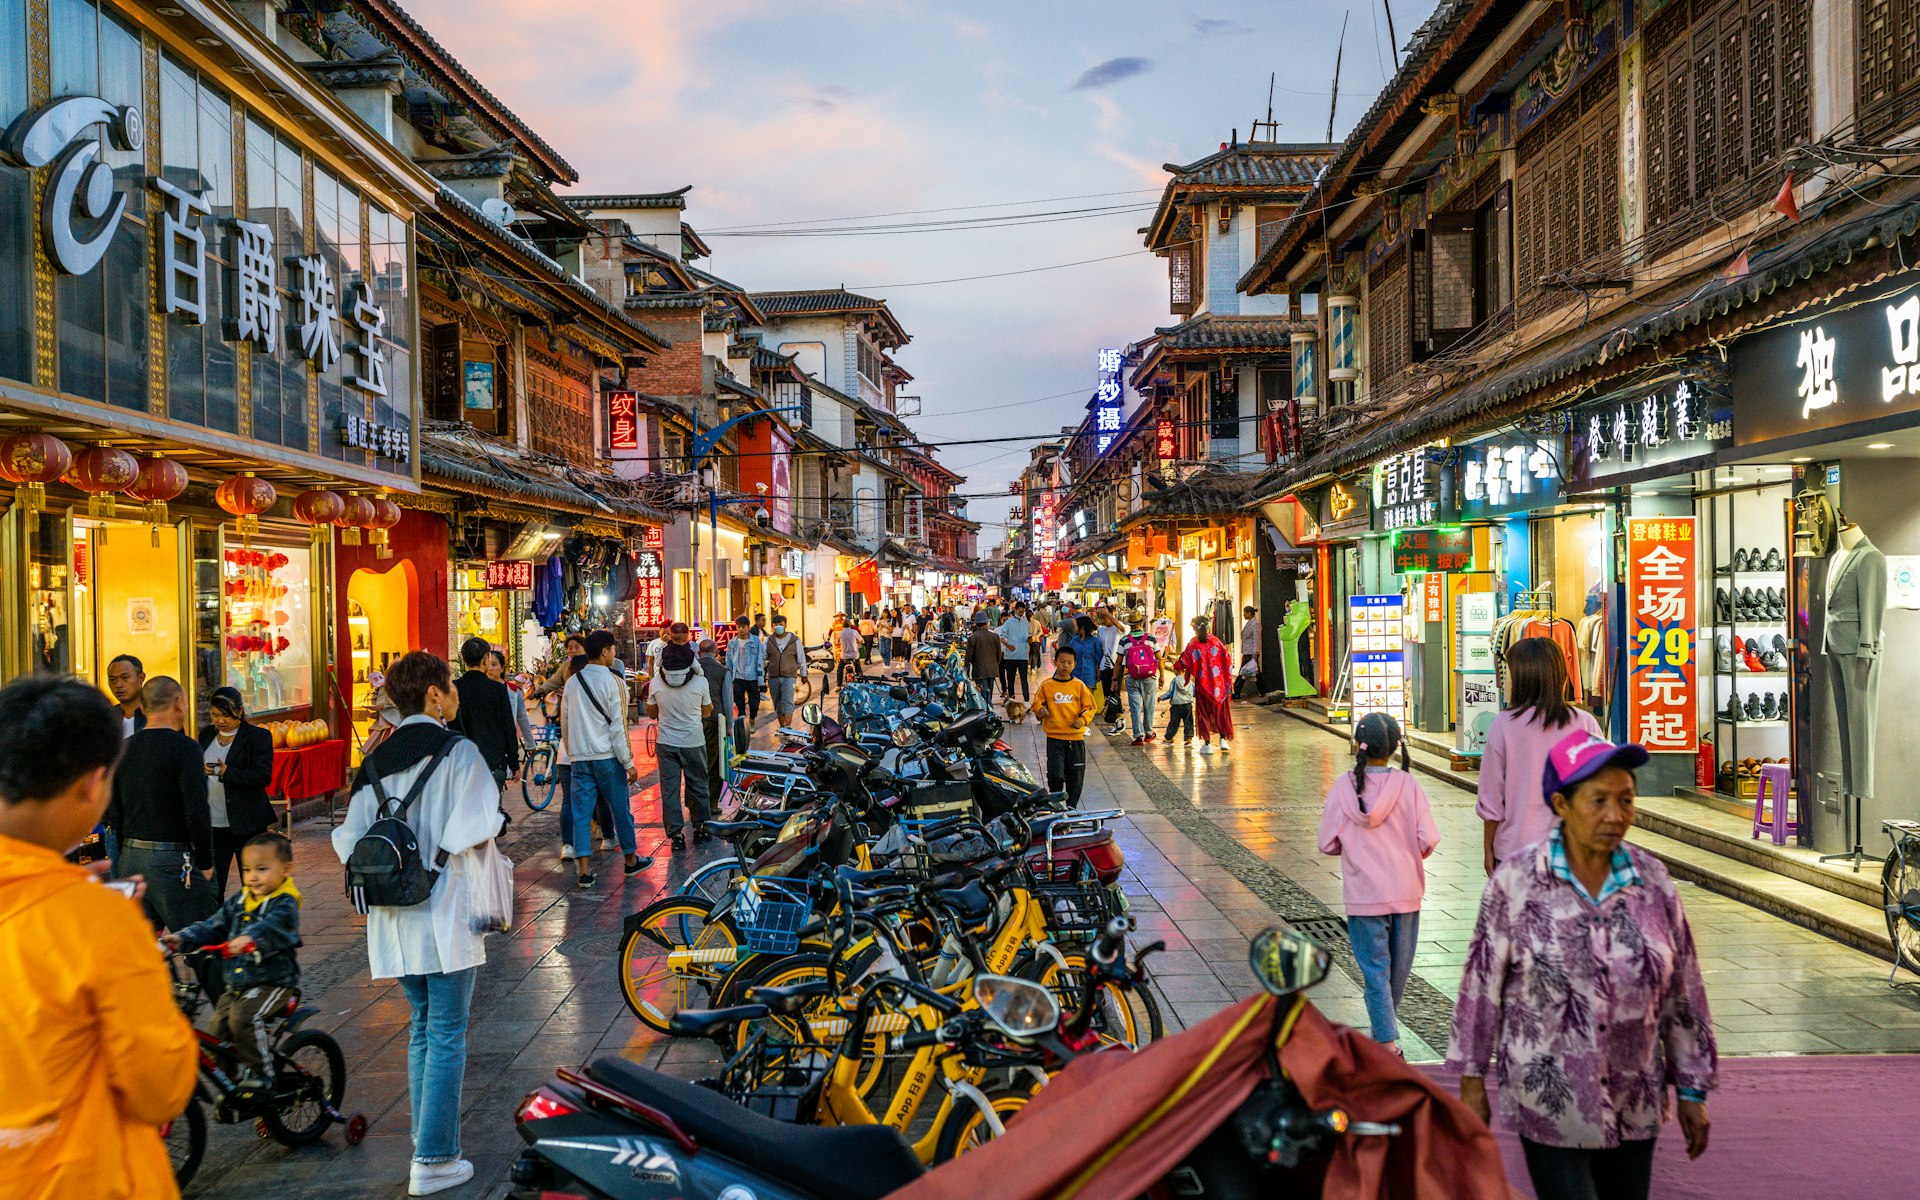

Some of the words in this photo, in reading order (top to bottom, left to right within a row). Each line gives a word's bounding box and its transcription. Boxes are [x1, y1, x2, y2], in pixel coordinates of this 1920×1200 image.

[152, 177, 388, 397] 百爵珠宝
[611, 393, 635, 442] 纹身
[1397, 533, 1429, 549] 汉堡
[1632, 522, 1692, 542] 登峰鞋业
[1397, 554, 1430, 570] 牛排
[1437, 553, 1470, 569] 披萨
[1465, 689, 1496, 702] 不断电
[896, 1098, 913, 1122] App
[908, 1071, 927, 1097] 扫码
